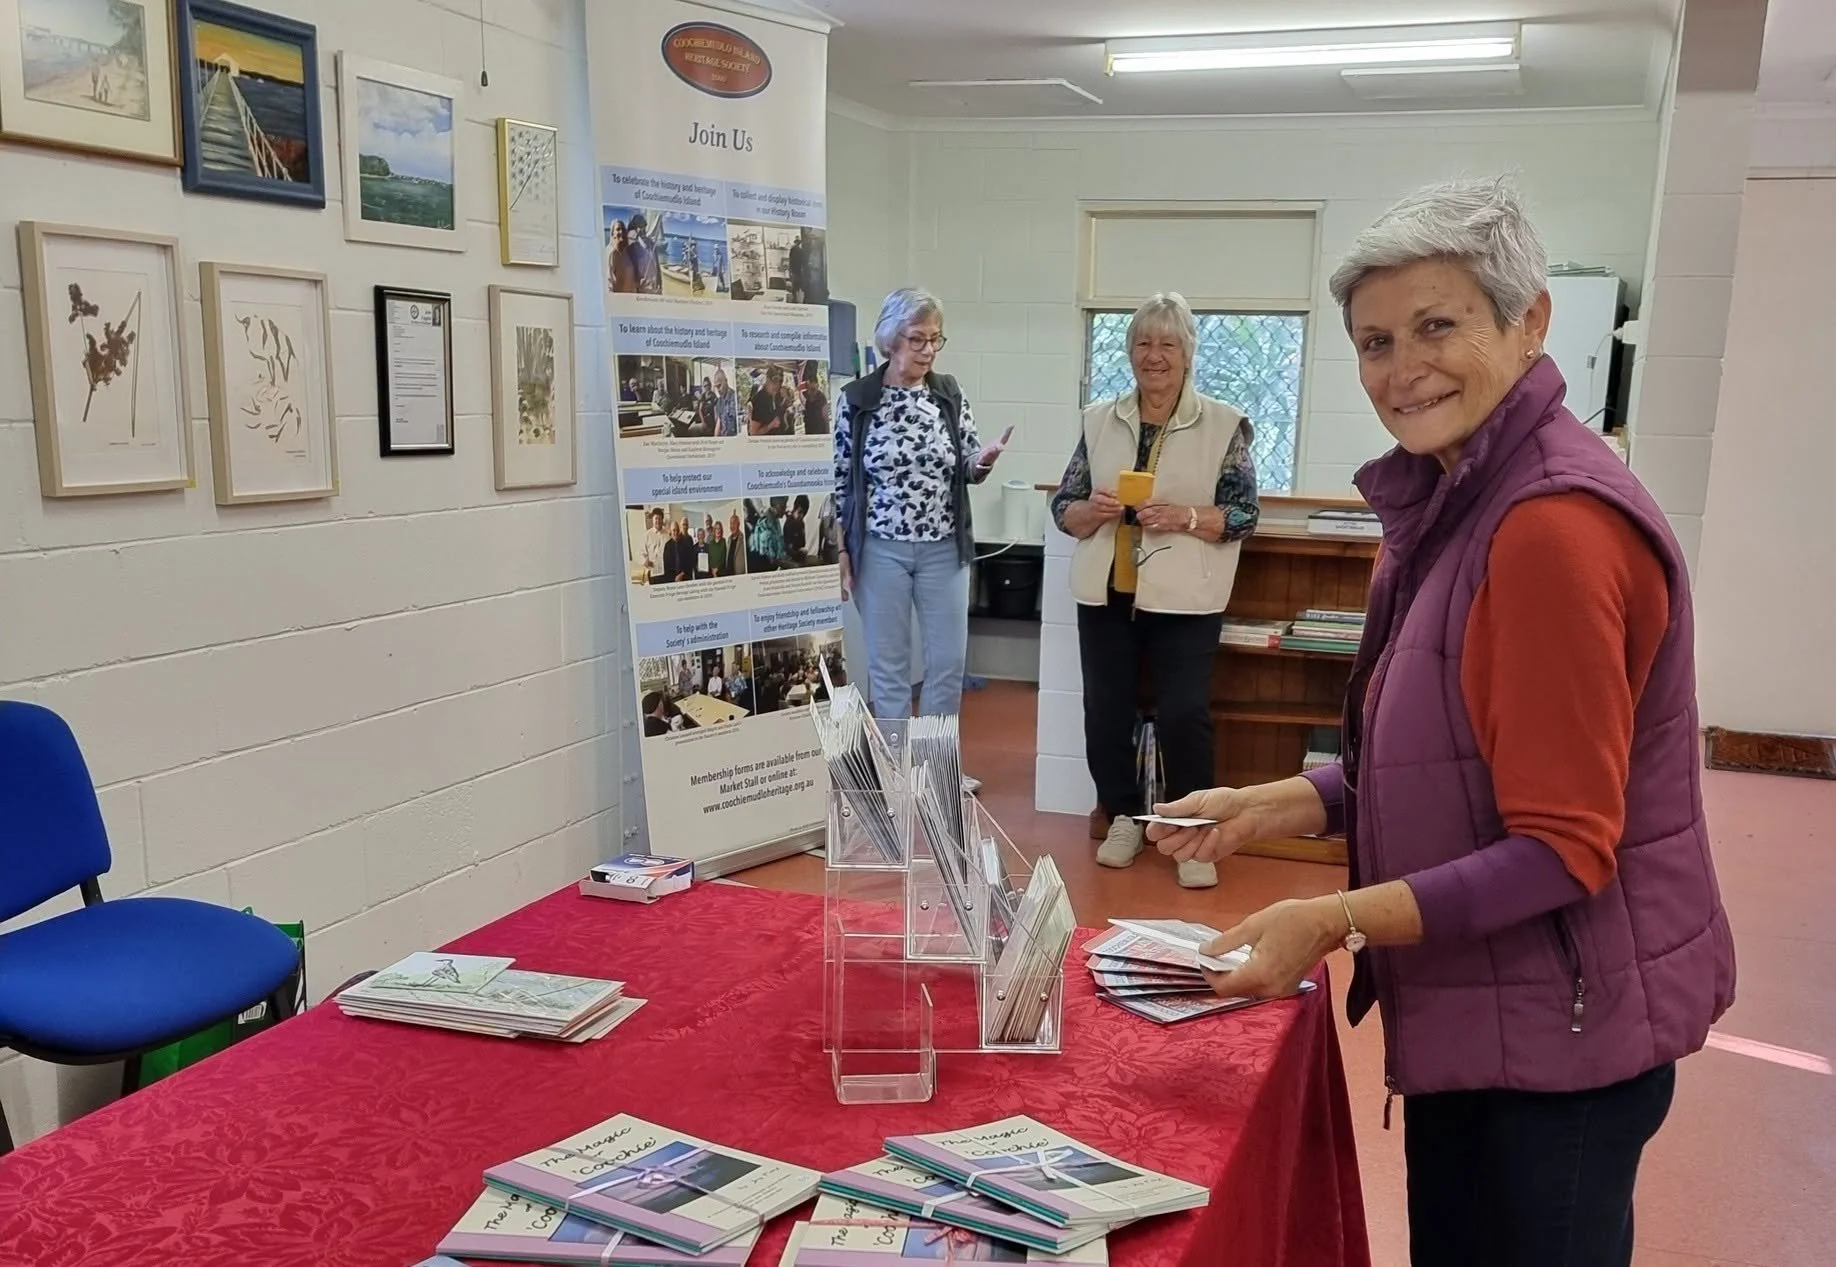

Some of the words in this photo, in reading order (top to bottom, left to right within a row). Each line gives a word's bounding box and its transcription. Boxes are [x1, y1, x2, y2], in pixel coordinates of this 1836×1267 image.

[688, 121, 727, 149] Join
[733, 129, 753, 152] Us
[612, 173, 620, 183] To
[622, 175, 649, 187] celebrate
[650, 179, 660, 188] the
[661, 181, 681, 192] history
[682, 183, 693, 192] and
[619, 324, 628, 333] To
[629, 324, 646, 334] learn
[647, 325, 664, 335] about
[674, 327, 694, 337] history
[741, 329, 749, 338] To
[770, 331, 780, 339] and
[645, 339, 652, 347] of
[693, 340, 711, 349] Island
[754, 343, 769, 351] about
[662, 473, 669, 483] To
[669, 473, 681, 484] help
[682, 473, 702, 483] protect
[757, 470, 765, 478] To
[797, 468, 807, 476] and
[651, 486, 671, 499] special
[671, 484, 688, 495] island
[688, 484, 724, 495] environment
[753, 614, 761, 623] To
[761, 614, 775, 623] enjoy
[775, 609, 800, 620] friendship
[800, 608, 810, 616] and
[810, 605, 835, 615] fellowship
[676, 624, 683, 634] To
[682, 623, 696, 634] help
[695, 621, 708, 631] with
[708, 620, 718, 629] the
[763, 624, 778, 634] other
[778, 621, 798, 631] Heritage
[798, 618, 816, 628] Society
[691, 768, 733, 786] Membership
[734, 763, 755, 776] forms
[755, 760, 766, 771] are
[766, 752, 795, 768] available
[795, 748, 811, 762] from
[811, 746, 822, 758] our
[719, 783, 744, 795] Market
[744, 777, 759, 789] Stall
[760, 775, 768, 784] or
[768, 769, 788, 783] online
[788, 766, 799, 778] at:
[540, 1152, 576, 1168] The
[576, 1126, 633, 1155] Magic
[905, 1174, 937, 1185] 'Co
[483, 1210, 508, 1231] The
[499, 1193, 521, 1211] Ma
[525, 1206, 558, 1230] 'Coo
[830, 1226, 849, 1247] The
